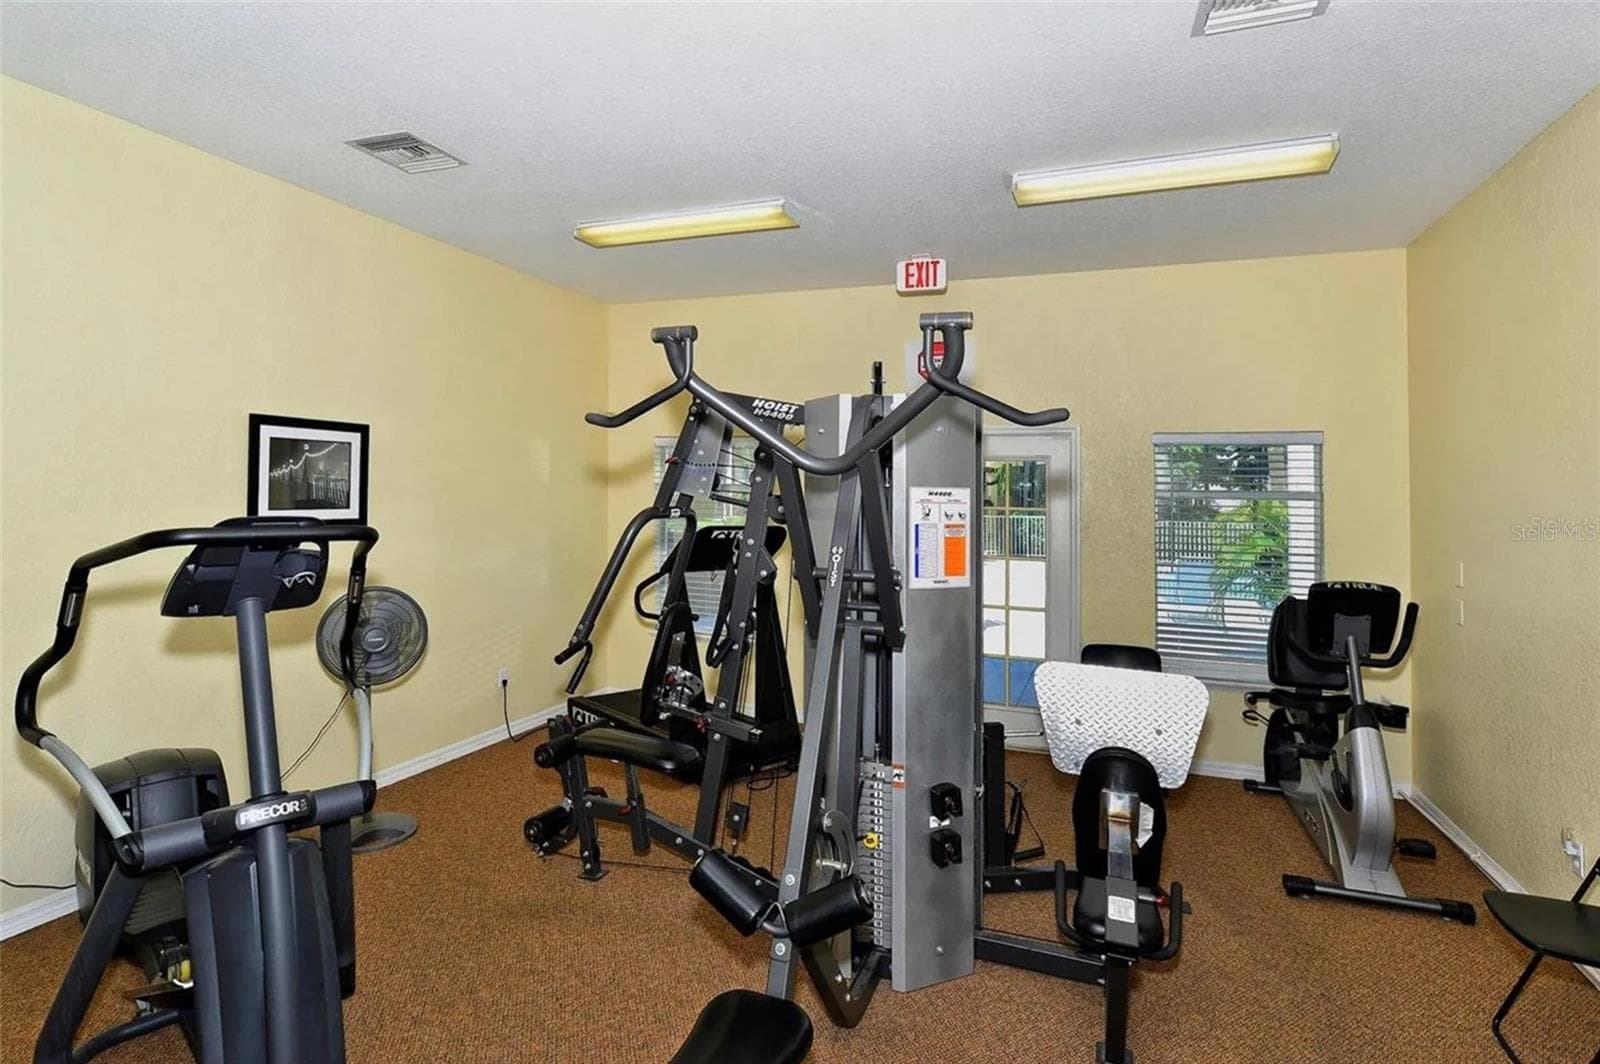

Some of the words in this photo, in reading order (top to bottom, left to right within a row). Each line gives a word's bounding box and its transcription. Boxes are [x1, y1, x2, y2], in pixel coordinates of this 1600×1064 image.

[904, 261, 940, 289] EXIT
[751, 399, 800, 414] HOIST
[753, 408, 795, 421] H4400
[239, 800, 300, 825] PRECOR
